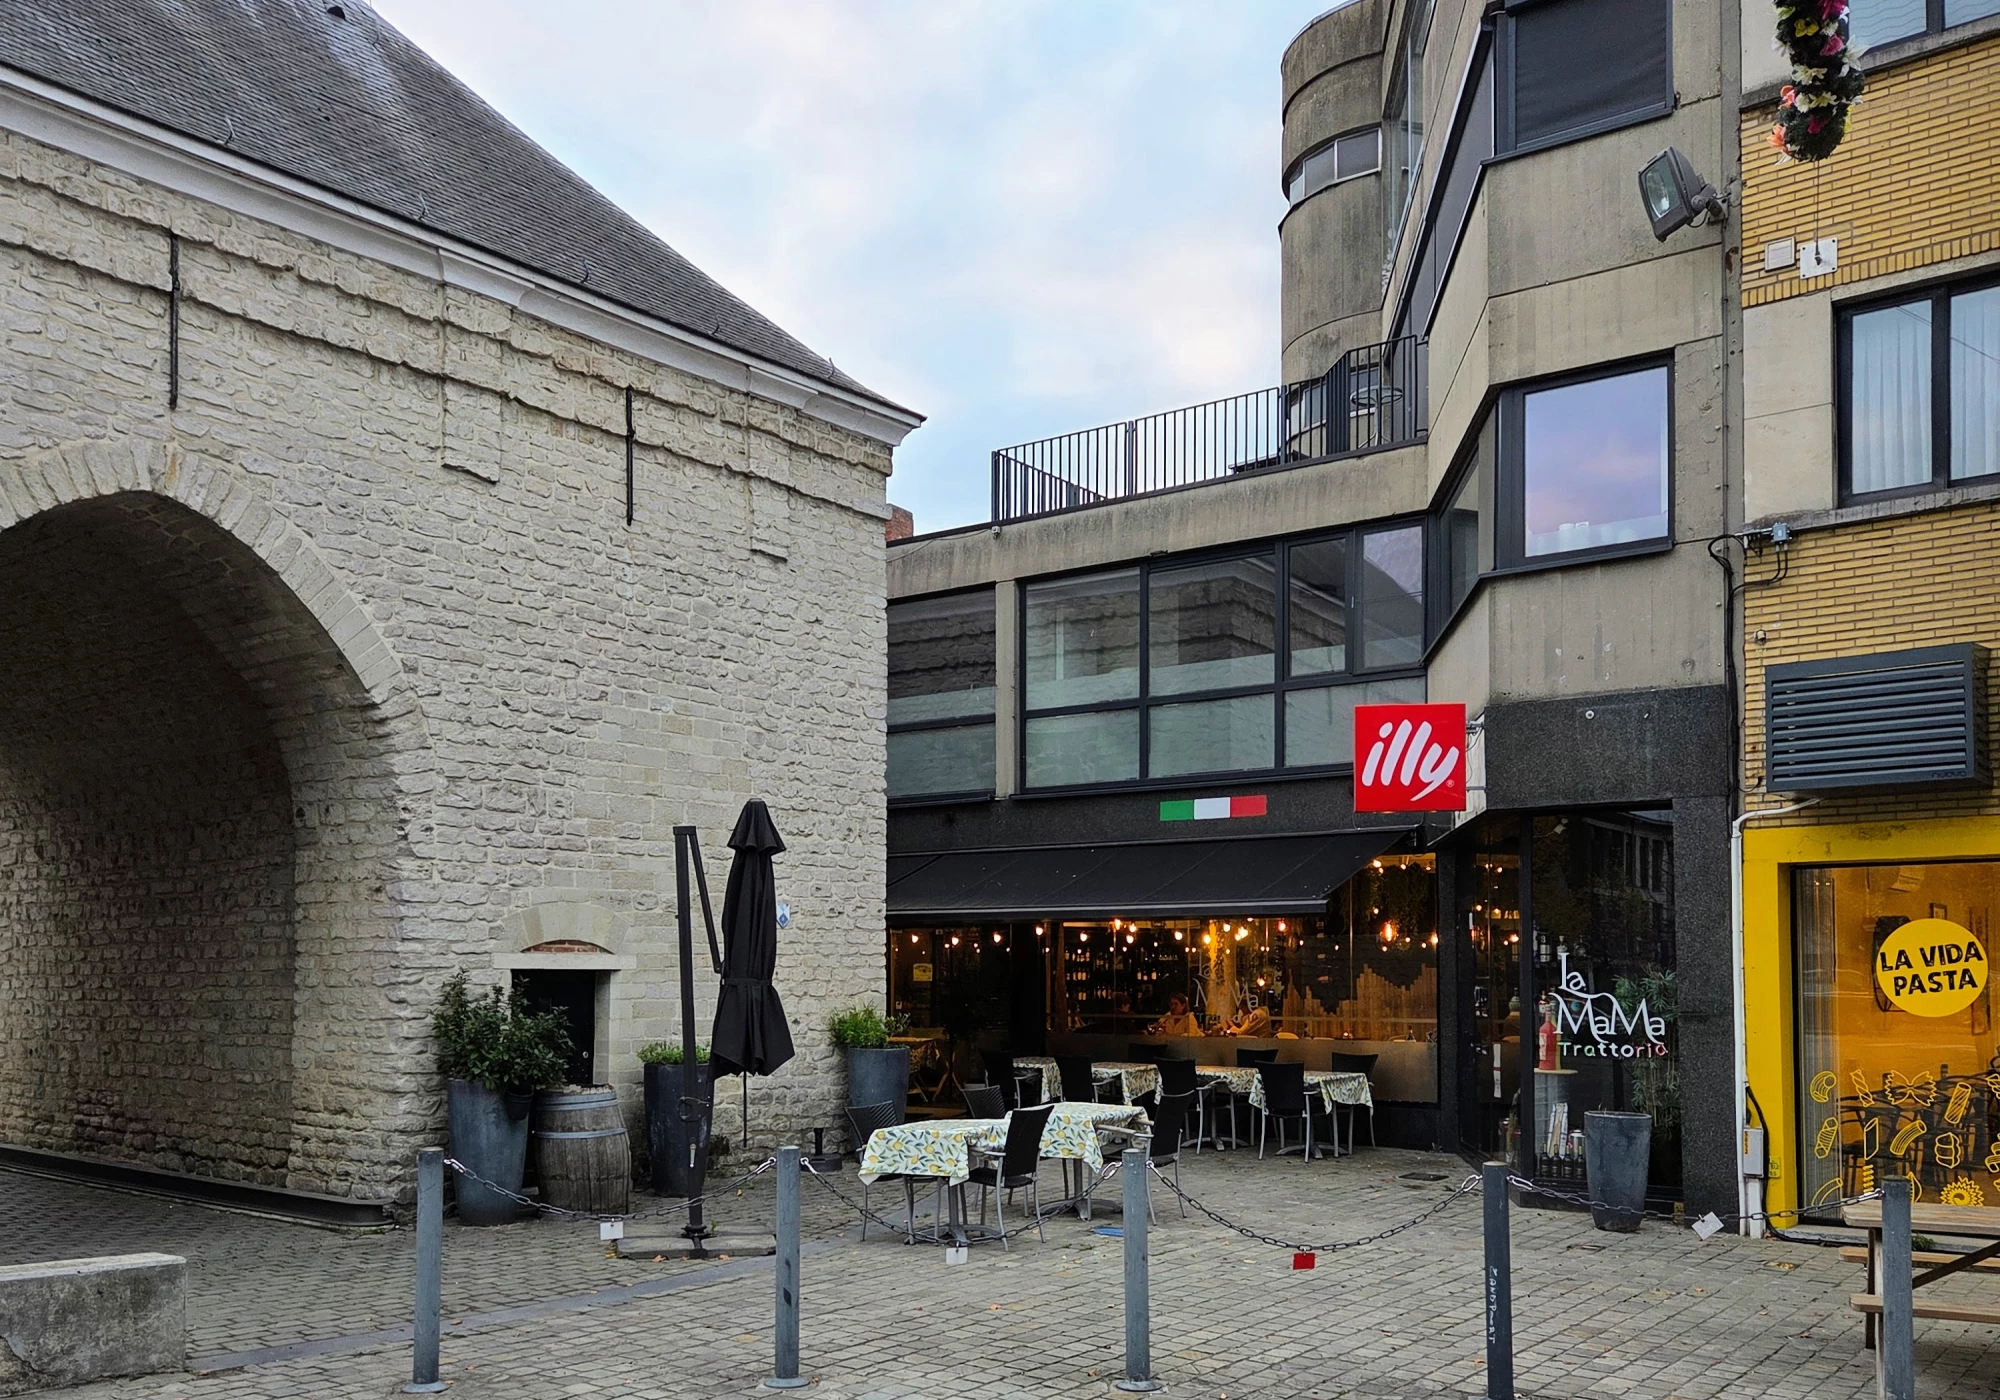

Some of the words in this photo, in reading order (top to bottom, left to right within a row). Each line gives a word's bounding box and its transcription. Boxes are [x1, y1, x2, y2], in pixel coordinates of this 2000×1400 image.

[1361, 719, 1460, 801] illy
[1880, 949, 1914, 972] LA
[1919, 941, 1984, 967] VIDA
[1893, 968, 1979, 997] PASTA
[1557, 1041, 1669, 1058] Trattoria
